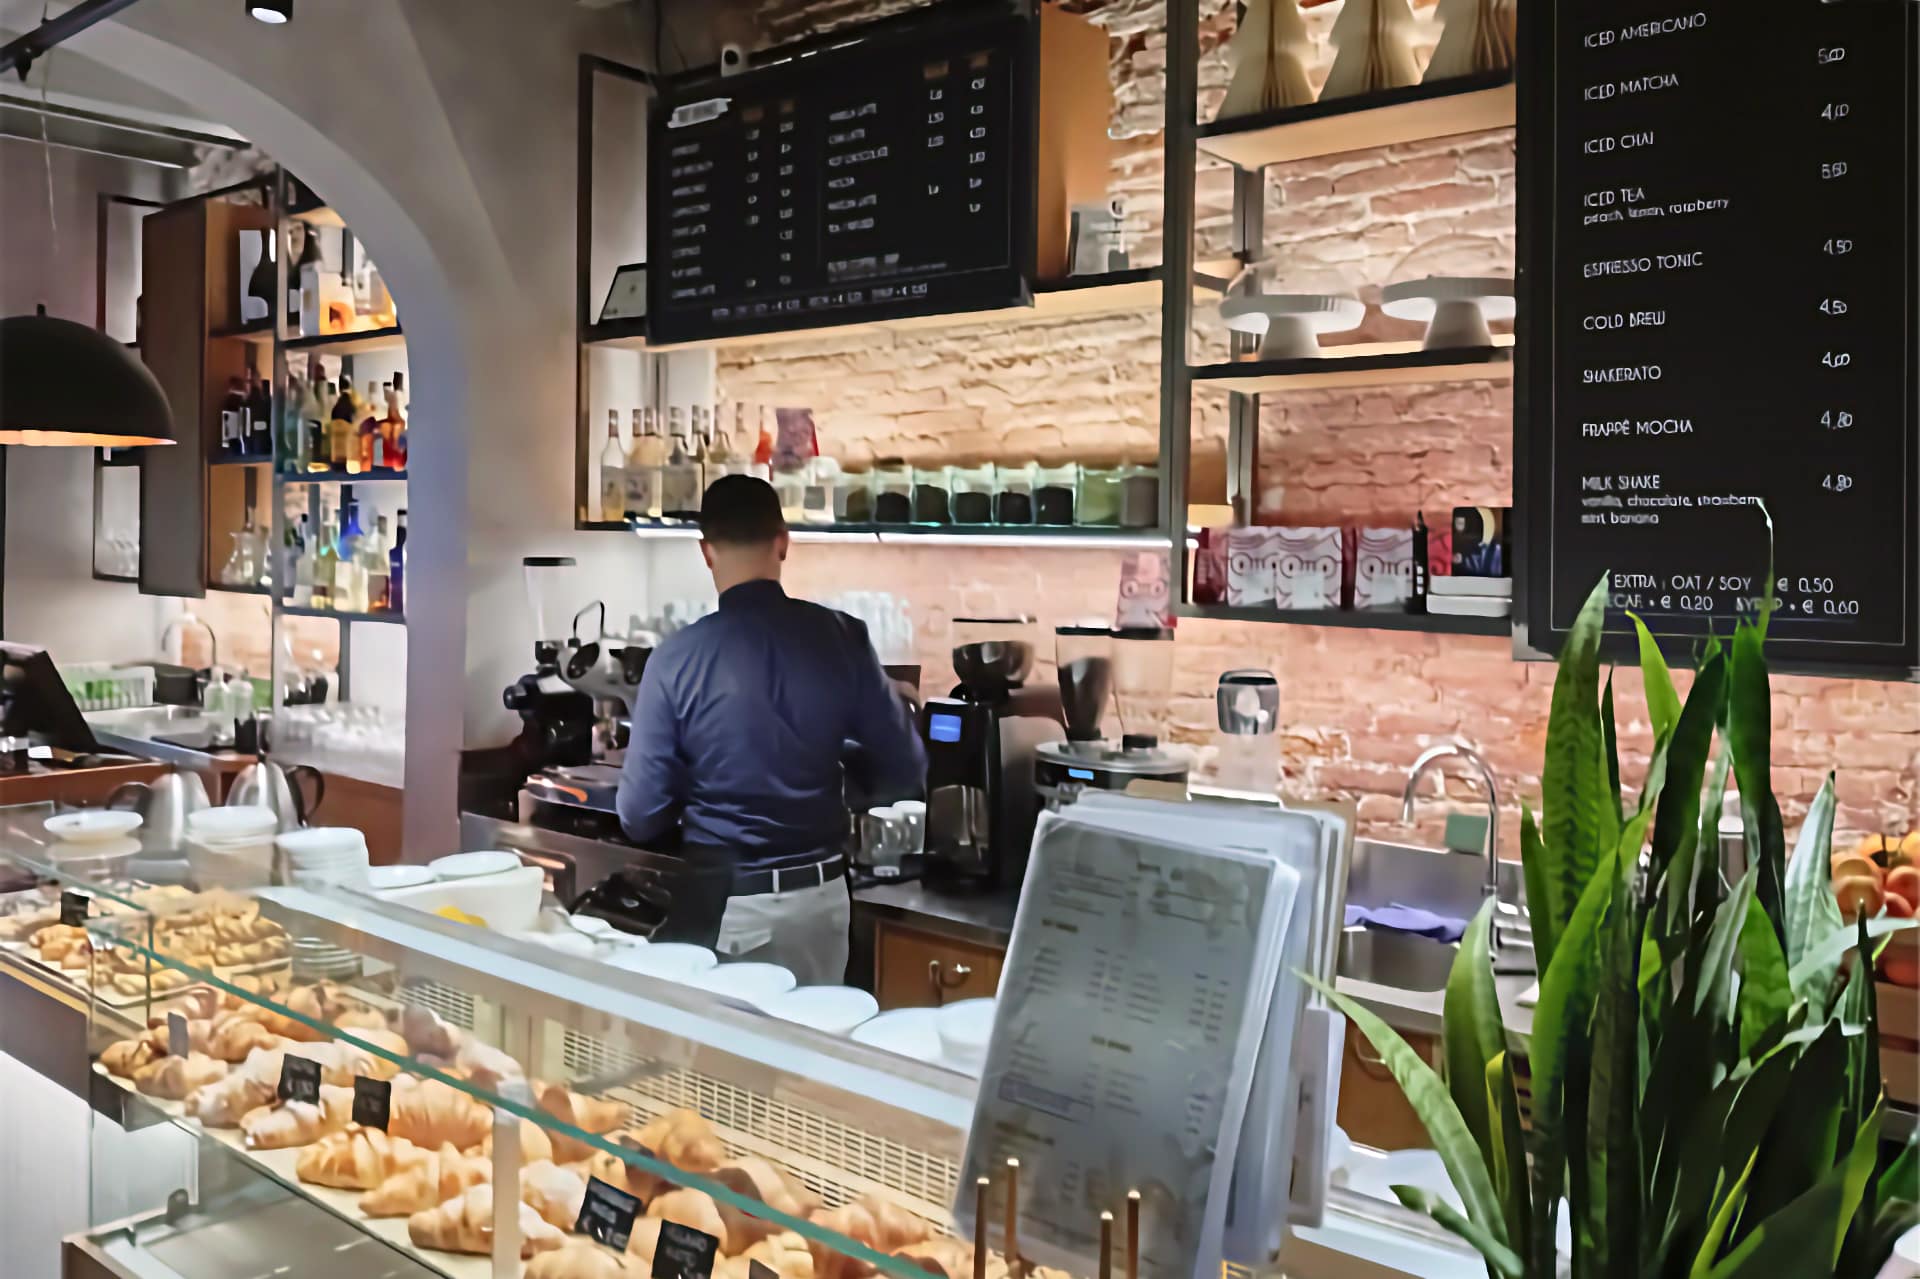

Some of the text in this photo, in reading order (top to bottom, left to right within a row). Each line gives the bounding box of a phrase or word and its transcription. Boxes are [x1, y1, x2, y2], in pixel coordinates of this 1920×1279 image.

[1584, 12, 1707, 48] ICED AMERICANO
[1584, 73, 1679, 101] ICED MATCHA
[1584, 131, 1654, 154] ICED CHAI
[1584, 187, 1645, 207] ICED TEA
[1583, 251, 1704, 278] ESPRESSO TONIC
[1583, 310, 1666, 331] COLD BREW
[1582, 365, 1662, 384] SHAKERATO
[1636, 418, 1694, 436] MOCHA
[1582, 474, 1661, 491] MILK SHAKE
[1613, 574, 1657, 591] EXTRA
[1671, 575, 1701, 591] OAT
[1719, 576, 1752, 591] SOY
